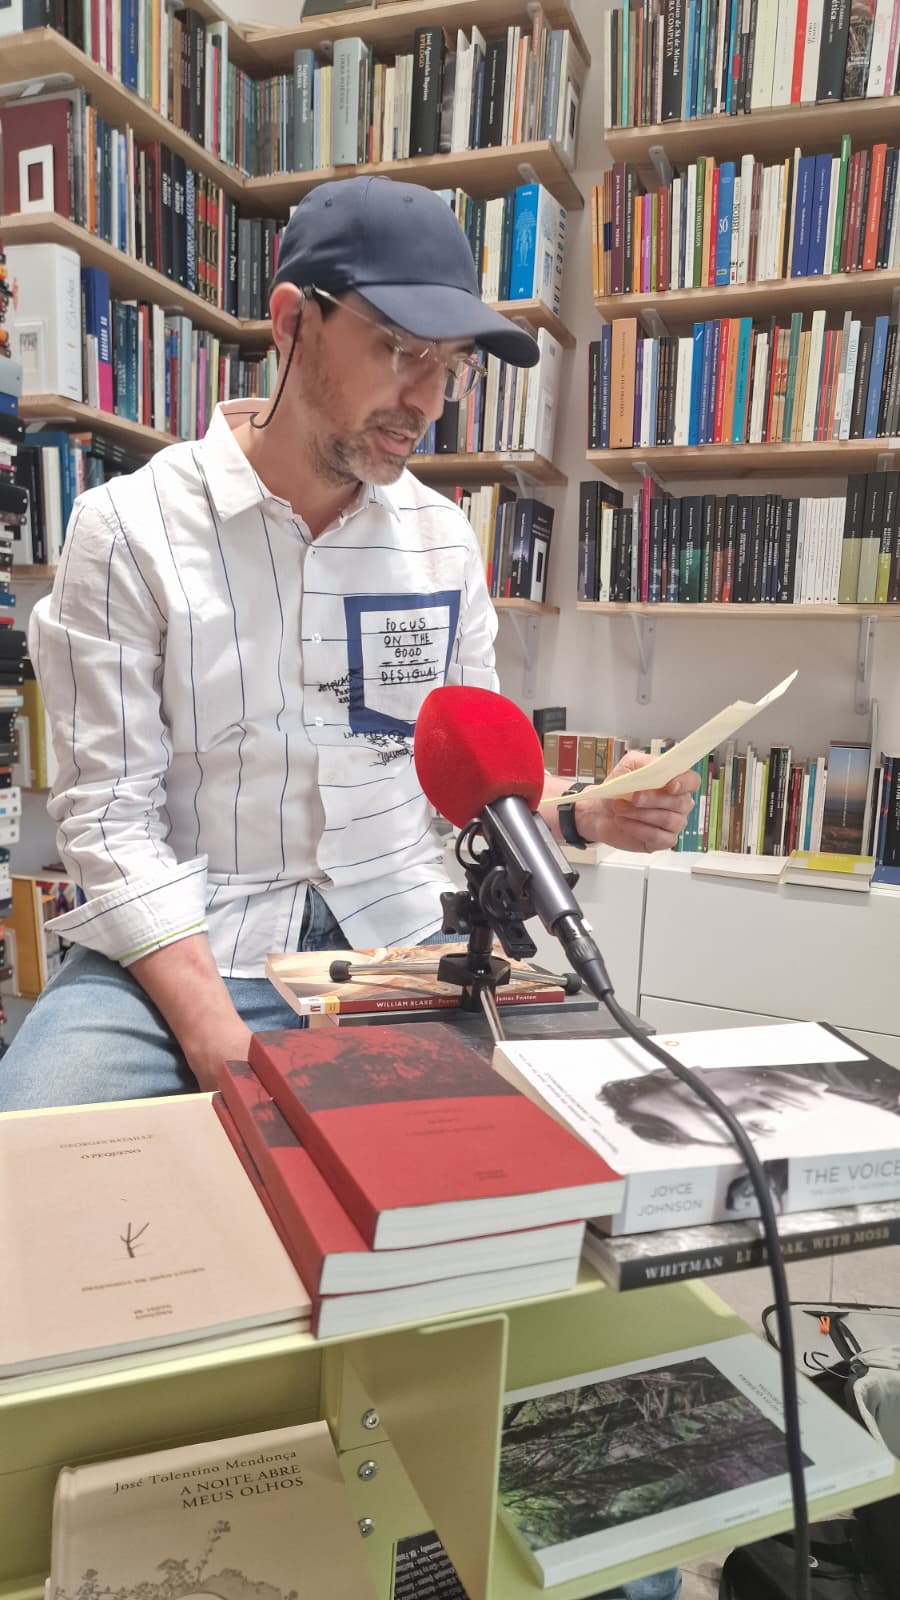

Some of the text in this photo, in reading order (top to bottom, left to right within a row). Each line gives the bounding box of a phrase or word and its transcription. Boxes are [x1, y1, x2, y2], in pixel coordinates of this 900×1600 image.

[386, 617, 426, 631] FOCUS
[384, 632, 430, 647] ON THE
[394, 647, 422, 658] GOOD
[376, 1000, 409, 1008] WILLIAM
[410, 999, 433, 1007] BLAKE
[803, 1166, 841, 1185] THE
[649, 1182, 693, 1199] JOYCE
[637, 1199, 702, 1217] JOHNSON
[645, 1255, 724, 1280] WHITMAN
[812, 1233, 851, 1251] WITH
[853, 1225, 890, 1243] MOSS
[113, 1450, 297, 1495] José Tolentino Mendonça
[180, 1463, 301, 1497] A NOITE ABRE
[182, 1475, 304, 1510] MEUS OLHOS
